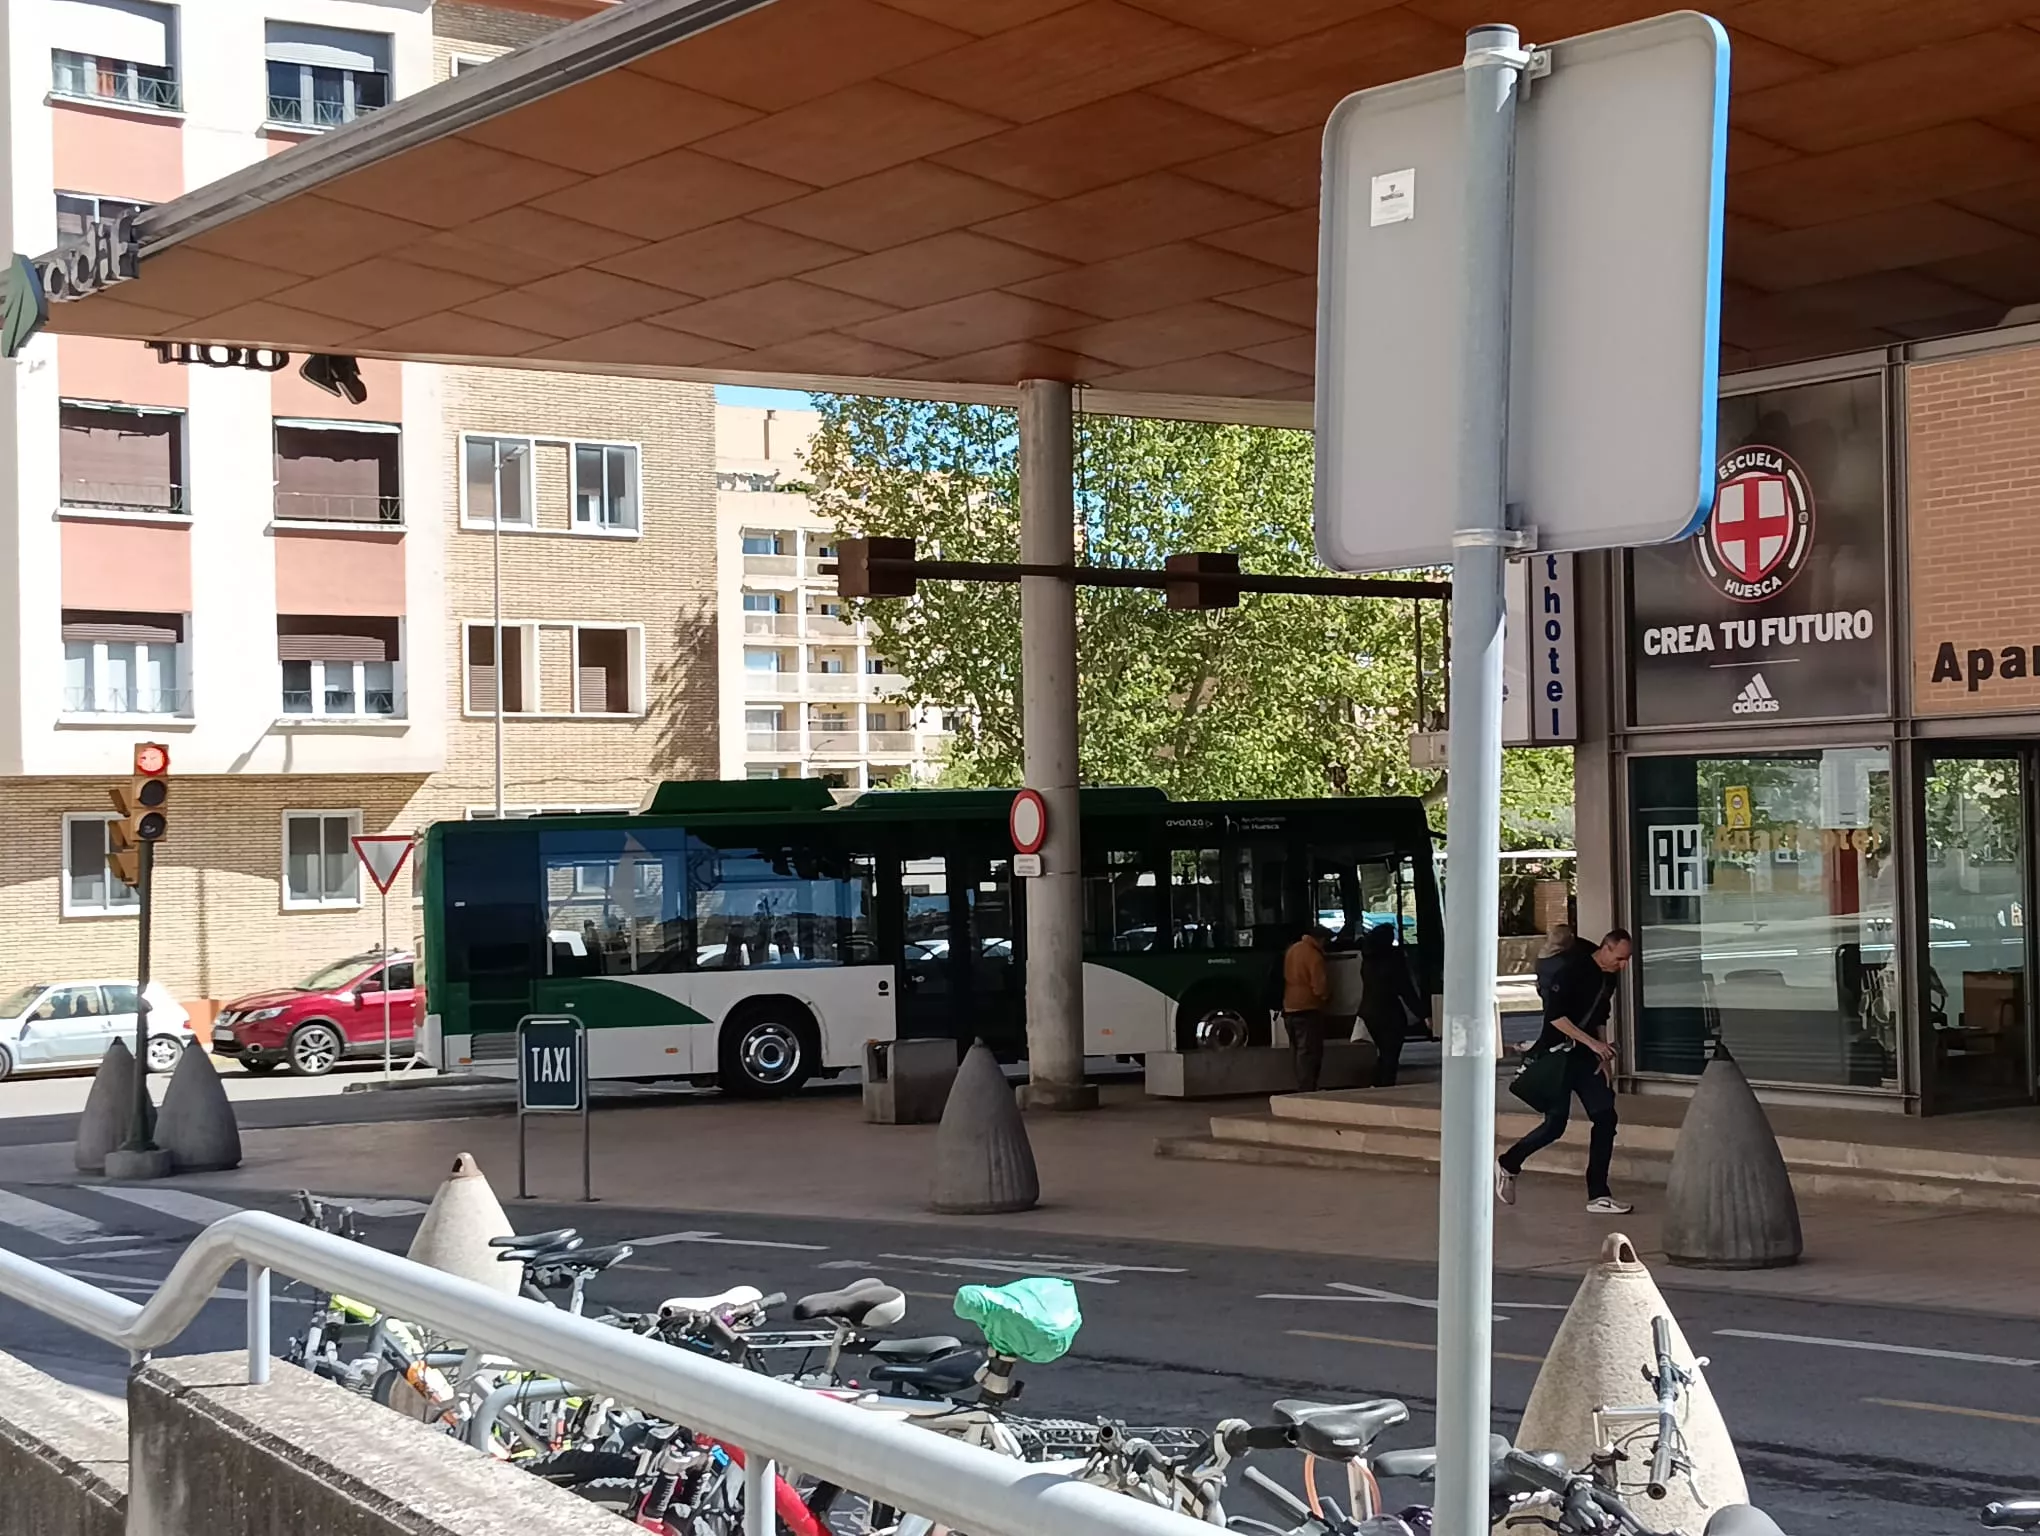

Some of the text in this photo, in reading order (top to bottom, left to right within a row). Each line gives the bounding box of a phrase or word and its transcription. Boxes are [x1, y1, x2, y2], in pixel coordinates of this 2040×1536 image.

[1718, 452, 1784, 480] ESCUELA
[1723, 575, 1783, 598] HUESCA
[1643, 608, 1874, 656] CREA TU FUTURO
[1731, 698, 1780, 715] adidas
[1165, 818, 1205, 828] avanza
[531, 1046, 571, 1083] TAXI
